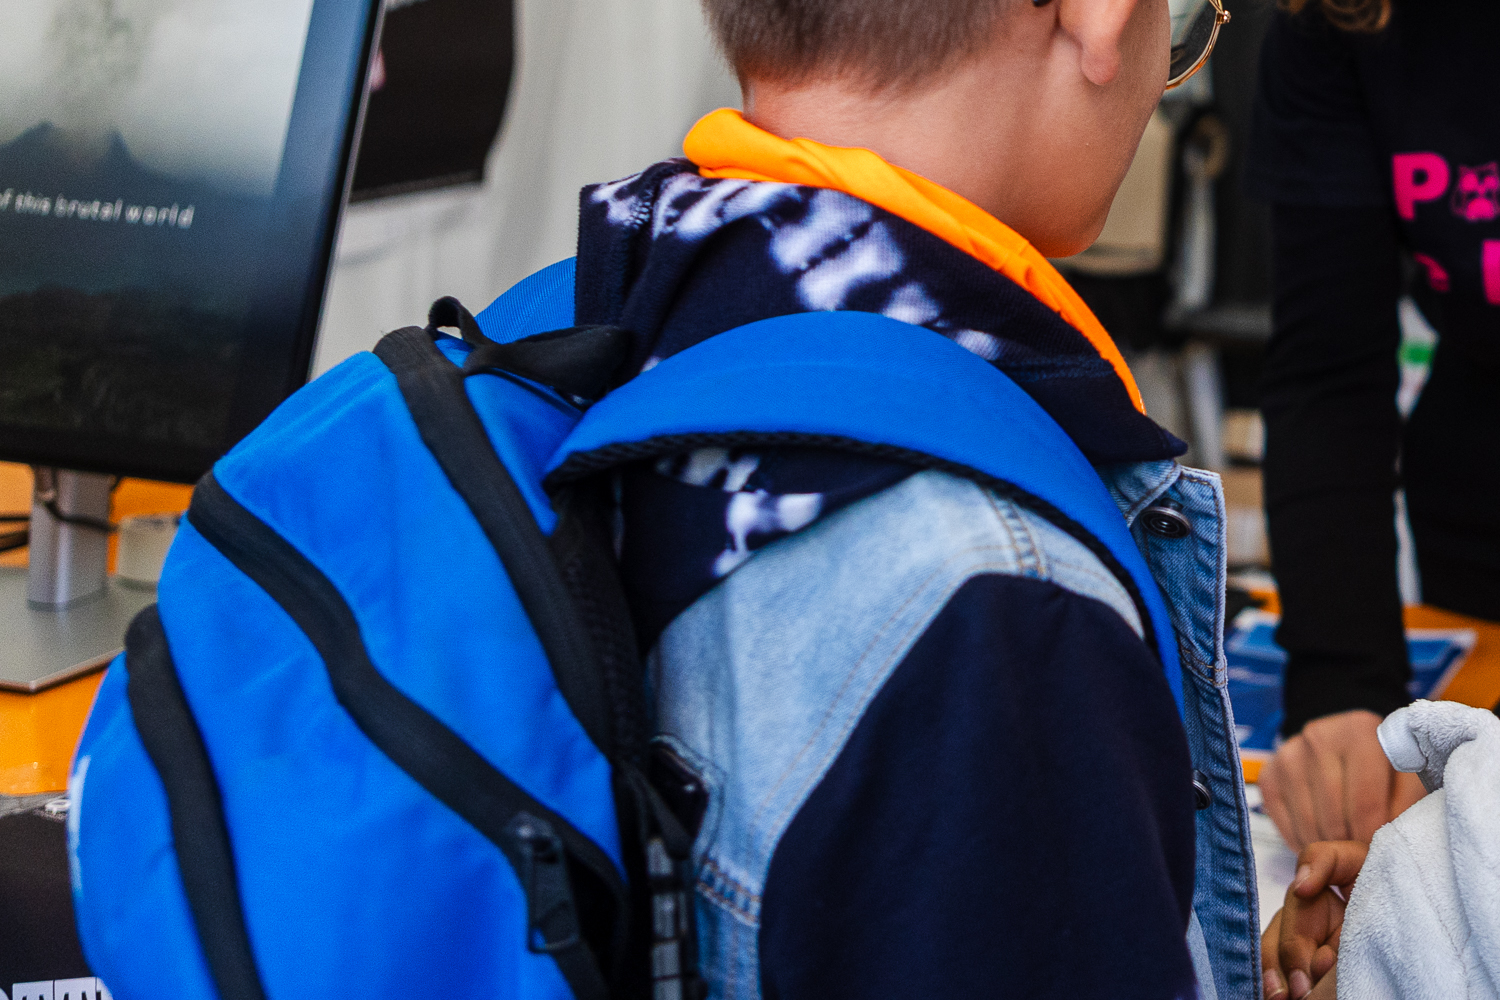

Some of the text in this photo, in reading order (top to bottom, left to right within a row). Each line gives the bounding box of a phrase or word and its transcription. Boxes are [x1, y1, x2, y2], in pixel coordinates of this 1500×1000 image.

[15, 189, 51, 216] this
[54, 193, 123, 222] brutal
[125, 202, 195, 229] world
